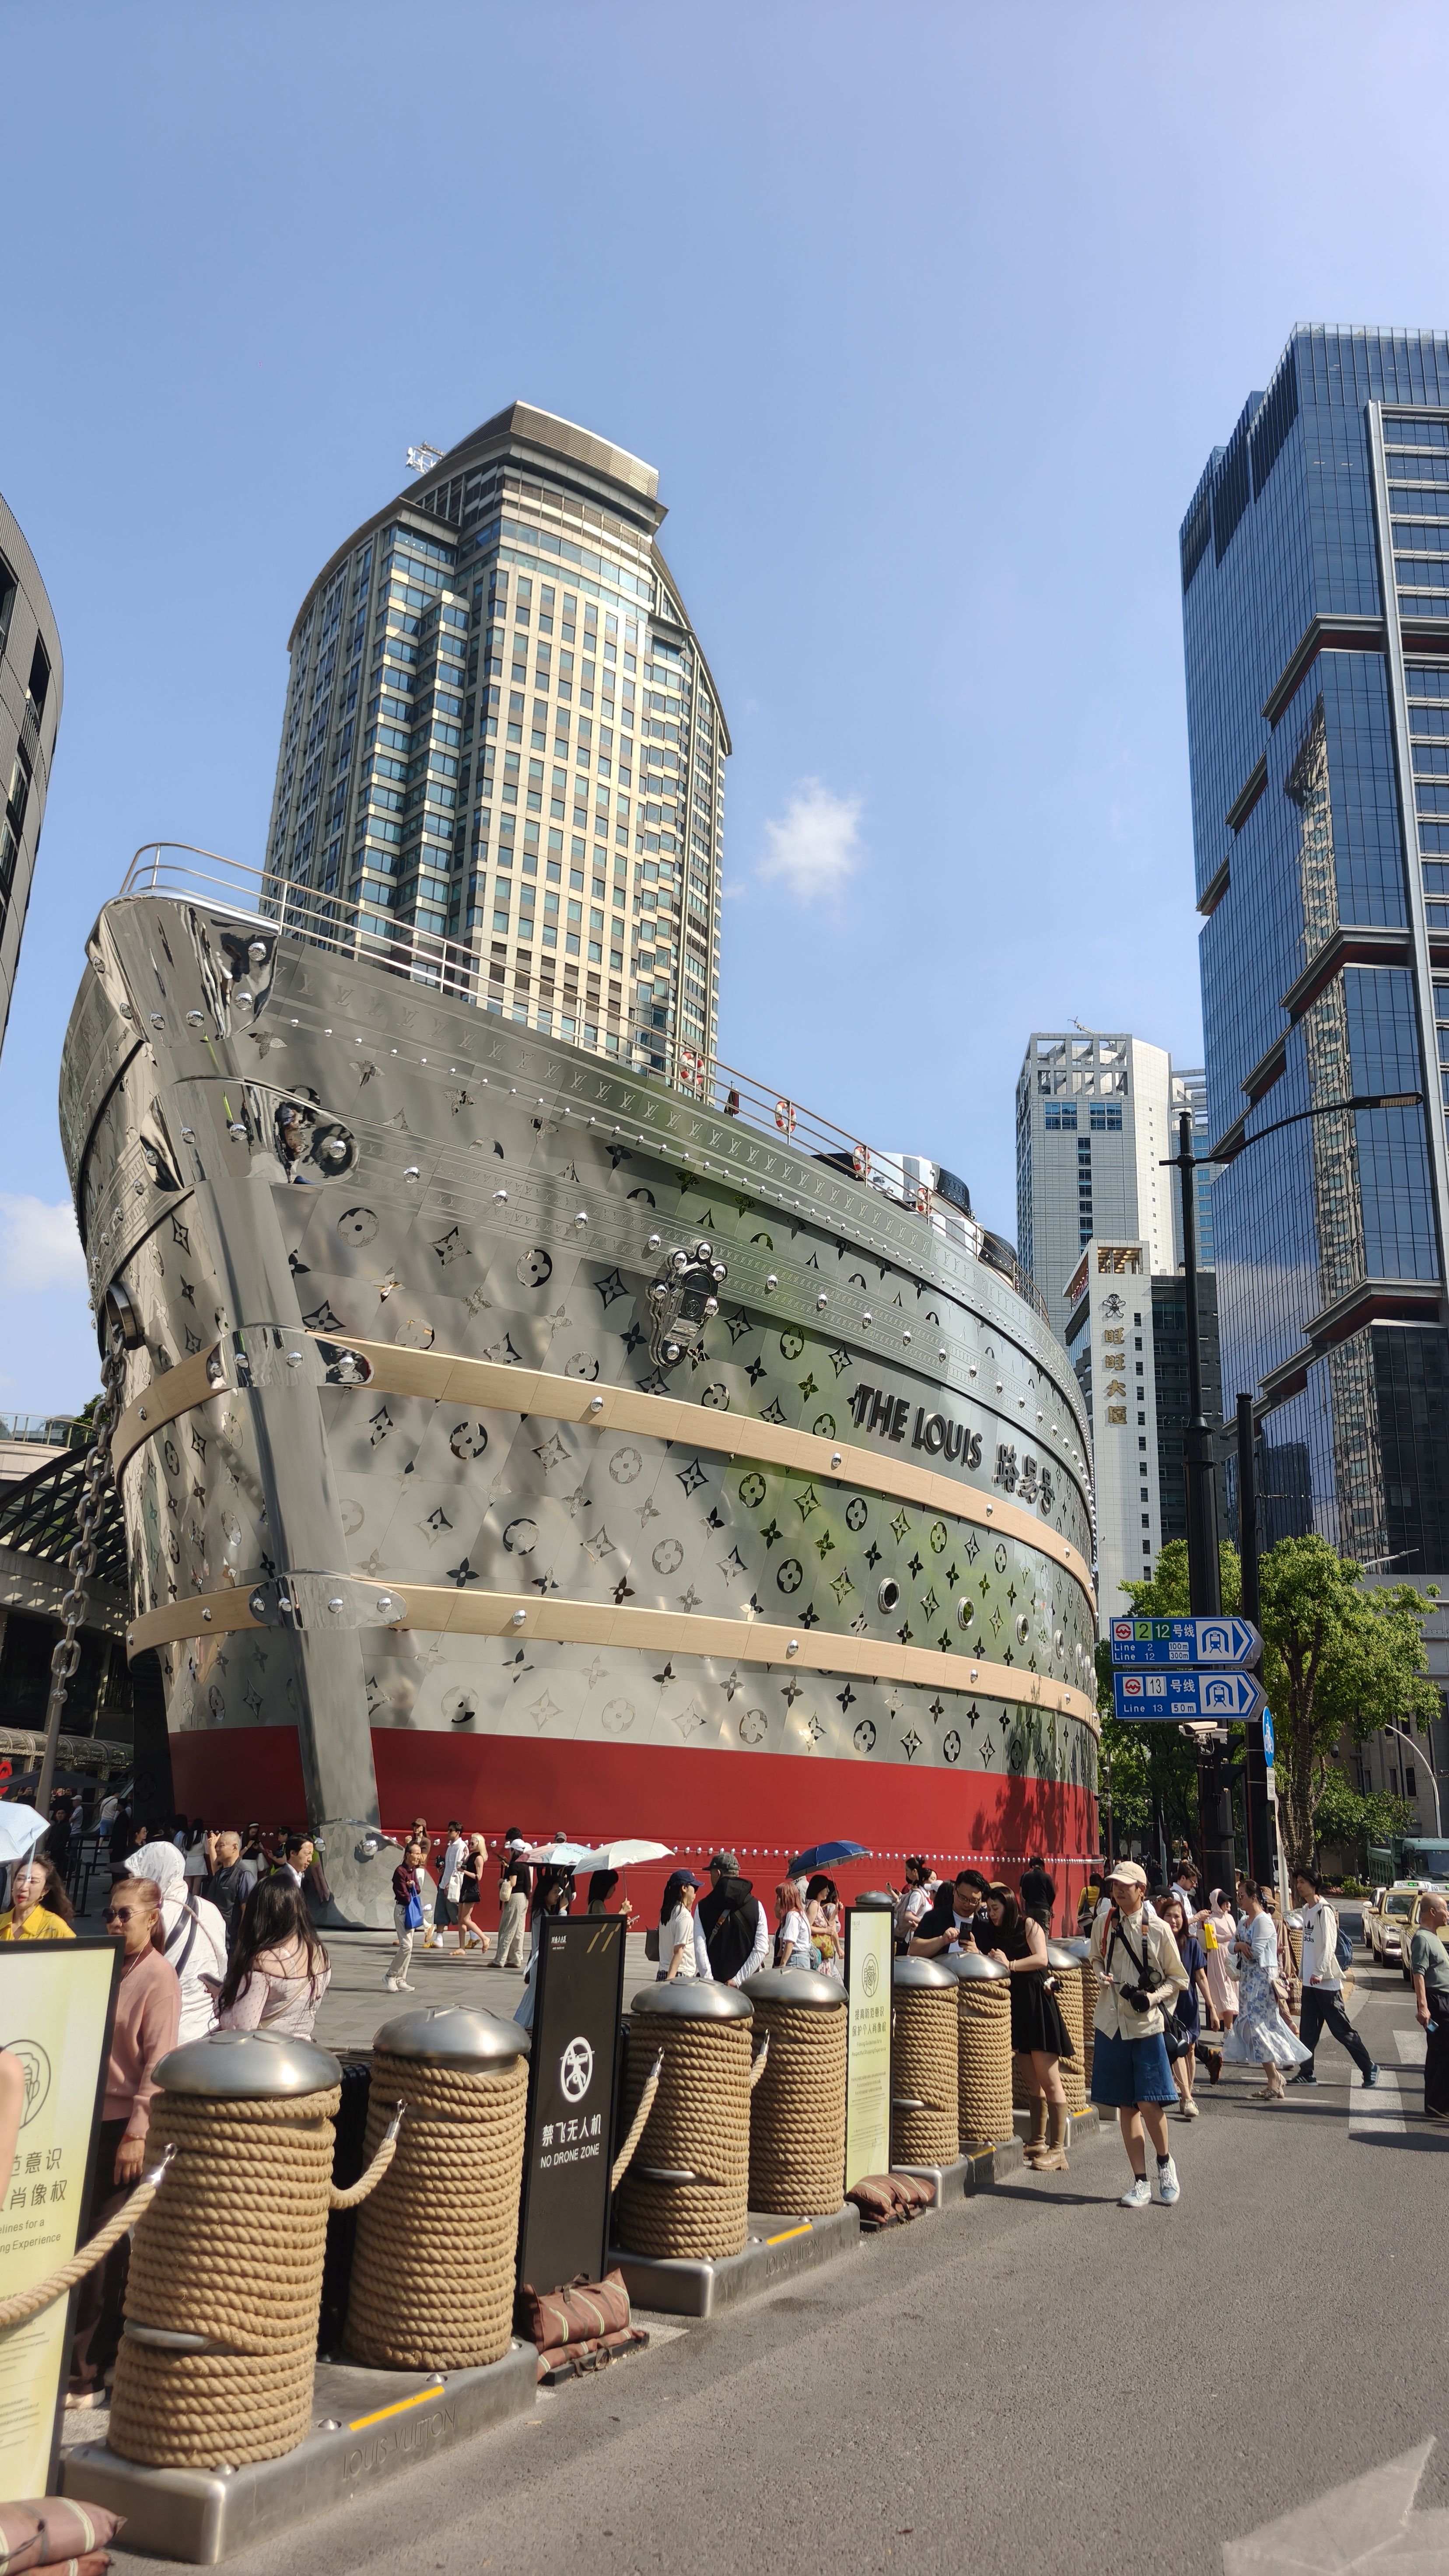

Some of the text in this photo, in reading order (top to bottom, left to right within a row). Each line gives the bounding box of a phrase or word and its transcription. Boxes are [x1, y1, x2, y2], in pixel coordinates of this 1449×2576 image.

[854, 1383, 1055, 1515] THE LOUIS 路易号
[1139, 1624, 1195, 1638] 2 12 号线
[1150, 1679, 1195, 1694] 13 号线
[855, 2006, 884, 2020] 提高防范意识
[852, 2022, 886, 2037] 保护个人肖像权
[542, 2114, 601, 2147] 禁飞无人机
[541, 2143, 599, 2169] NO DRONE ZONE
[26, 2220, 38, 2229] for
[13, 2233, 61, 2250] Experience
[766, 2236, 820, 2278] LOUIS VUITTON
[343, 2404, 456, 2481] LOUIS VUITTON
